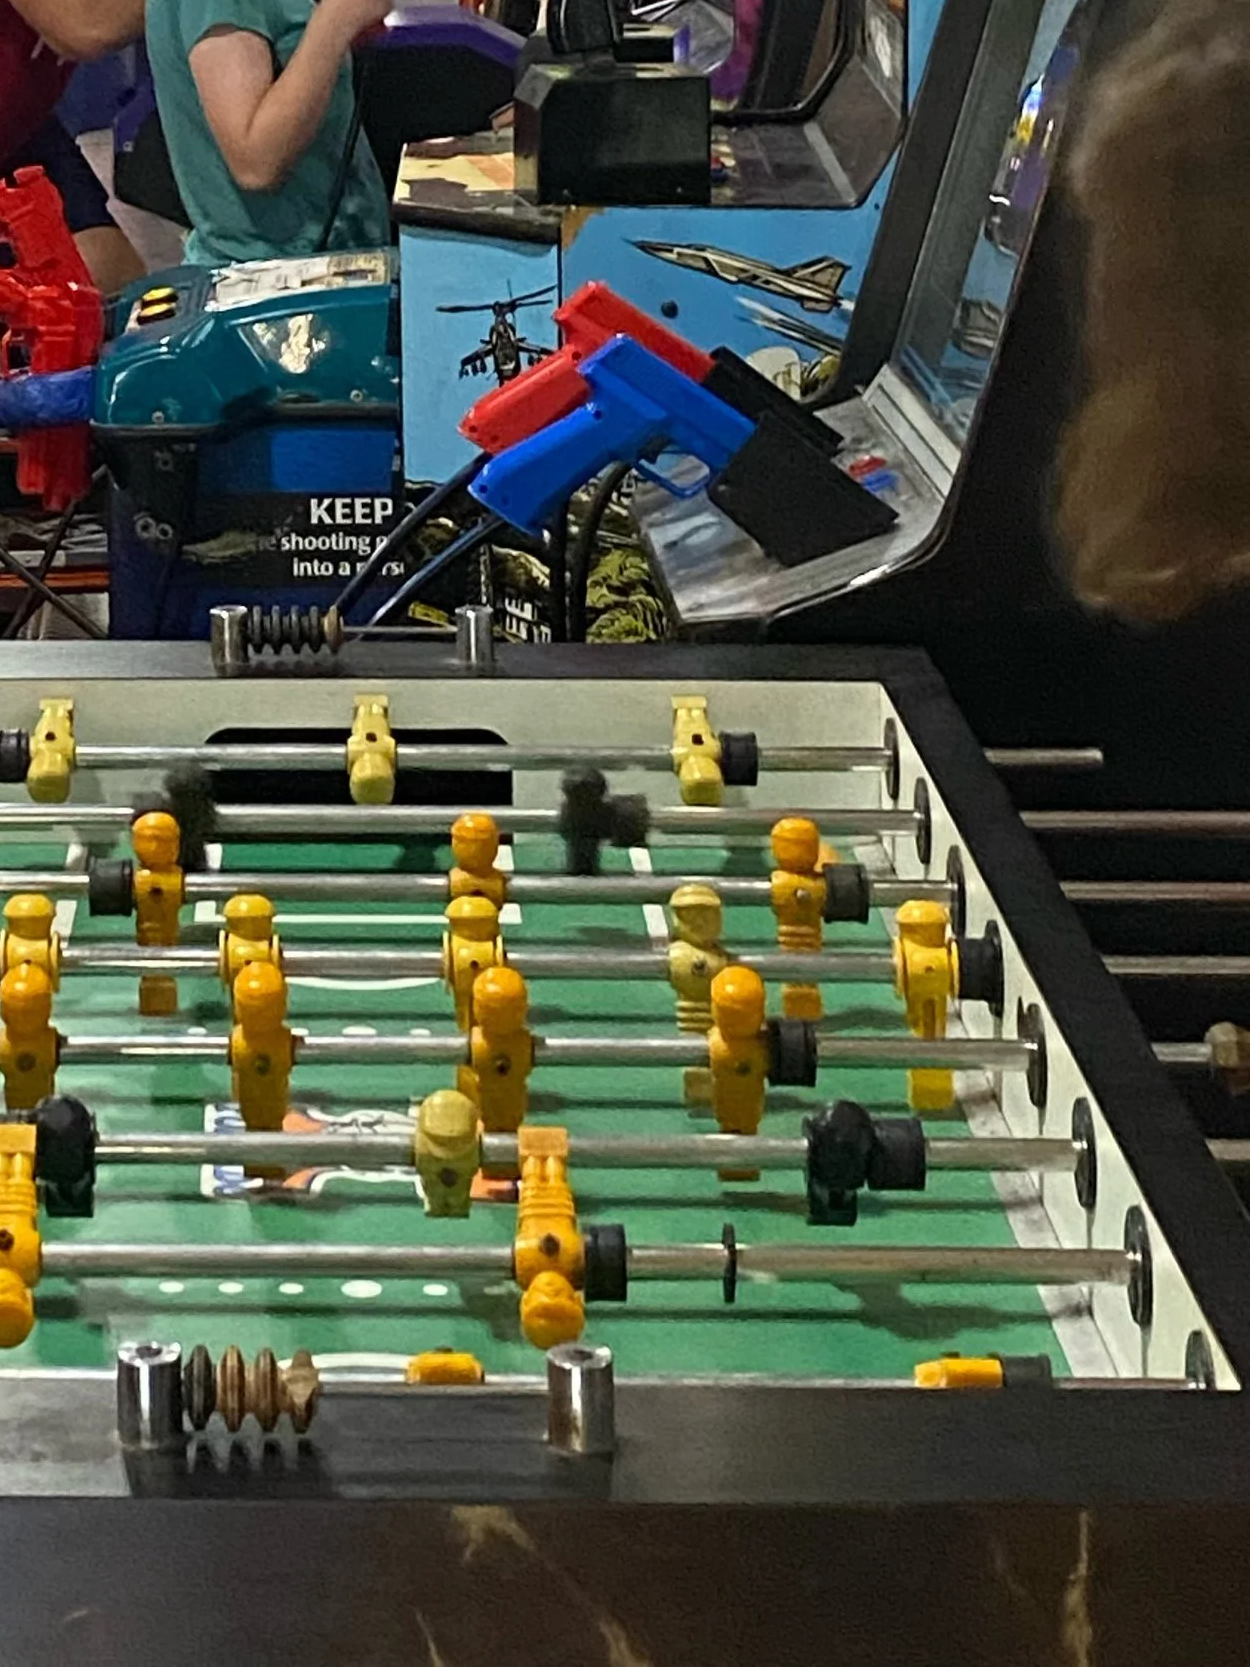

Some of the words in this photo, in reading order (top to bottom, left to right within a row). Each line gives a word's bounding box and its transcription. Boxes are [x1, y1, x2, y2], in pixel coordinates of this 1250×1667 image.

[310, 497, 393, 525] KEEP
[280, 532, 372, 556] shooting
[338, 560, 350, 577] a
